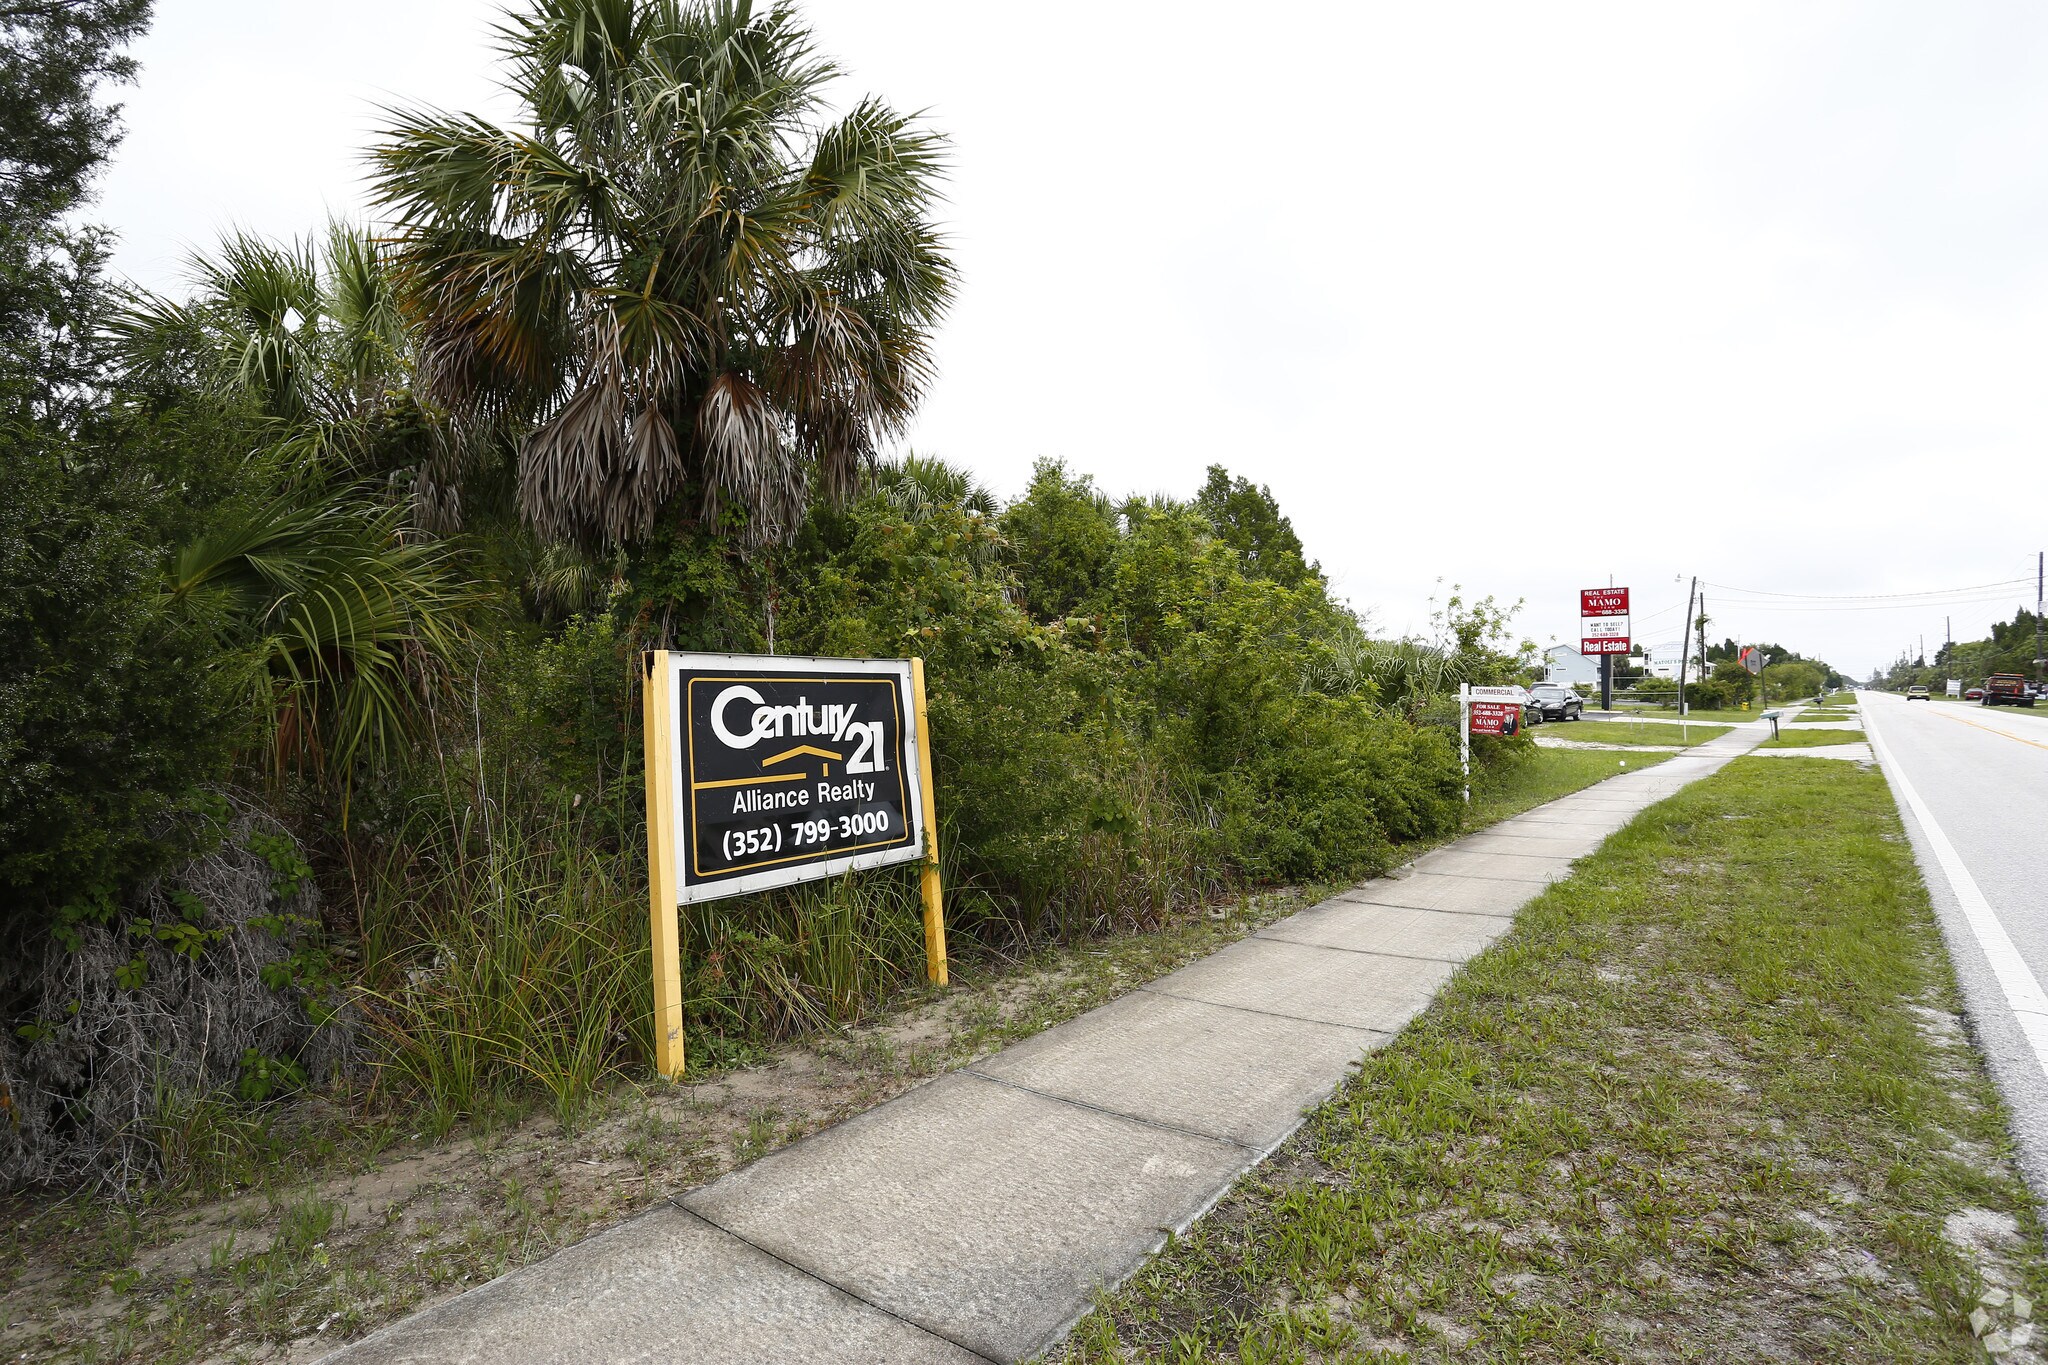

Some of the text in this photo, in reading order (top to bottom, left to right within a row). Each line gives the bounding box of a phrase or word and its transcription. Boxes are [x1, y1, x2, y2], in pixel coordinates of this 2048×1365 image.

[1589, 598, 1620, 606] MAMO
[1584, 640, 1627, 651] Real Estate
[711, 685, 886, 774] Century 21
[732, 779, 875, 814] Alliance Realty
[722, 810, 889, 861] (352) 799-3000
